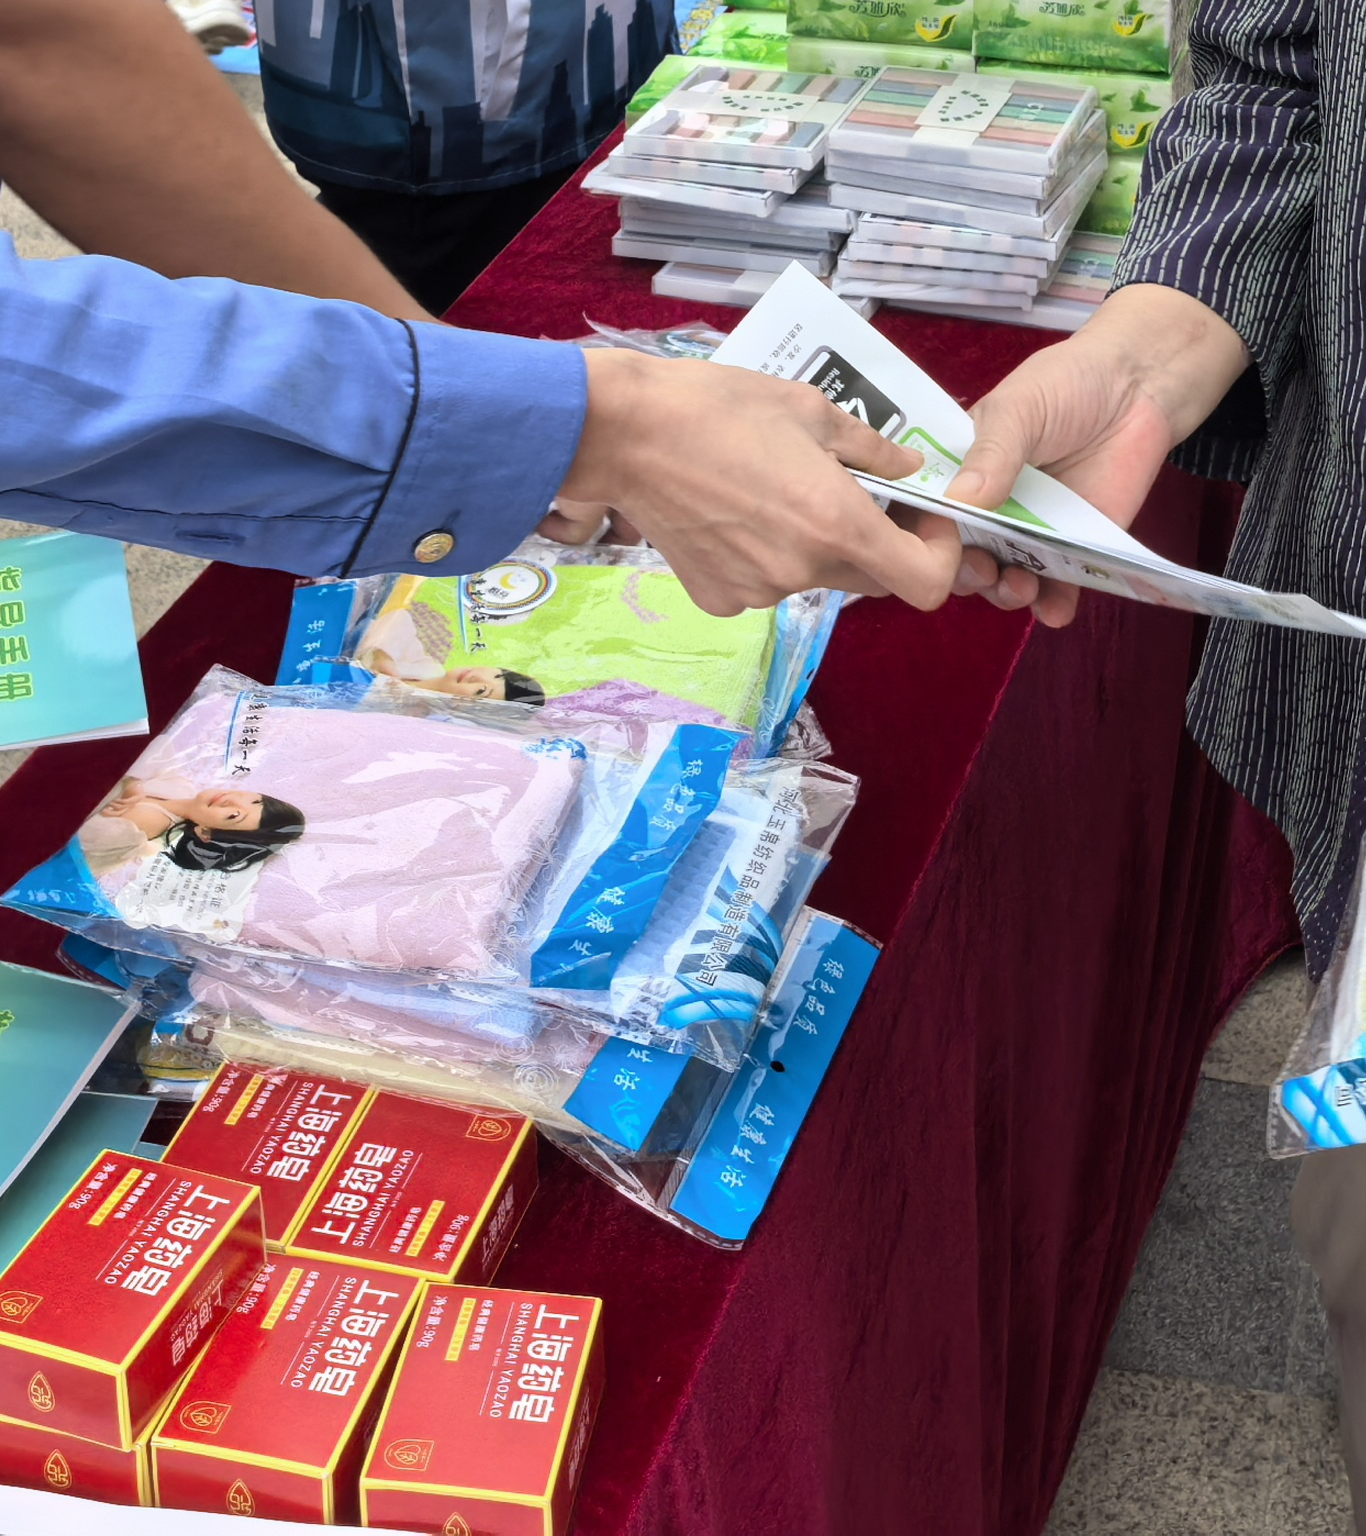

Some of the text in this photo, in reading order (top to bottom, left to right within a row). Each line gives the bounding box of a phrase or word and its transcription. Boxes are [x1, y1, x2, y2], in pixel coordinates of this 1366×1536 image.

[249, 1081, 315, 1175] SHANGHAI YAOZAO
[267, 1083, 352, 1182] 上海药皂
[121, 1184, 231, 1297] 上海药皂
[140, 1180, 192, 1238] SHANGHAI
[311, 1142, 397, 1245] 上海药皂
[352, 1149, 415, 1247] SHANGHAI YAOZAO
[104, 1240, 147, 1285] YAOZAO
[290, 1276, 357, 1388] SHANGHAI YAOZAO
[308, 1279, 400, 1396] 上海药皂
[489, 1301, 534, 1419] SHANGHAI YAOZAO
[508, 1303, 580, 1424] 上海药皂
